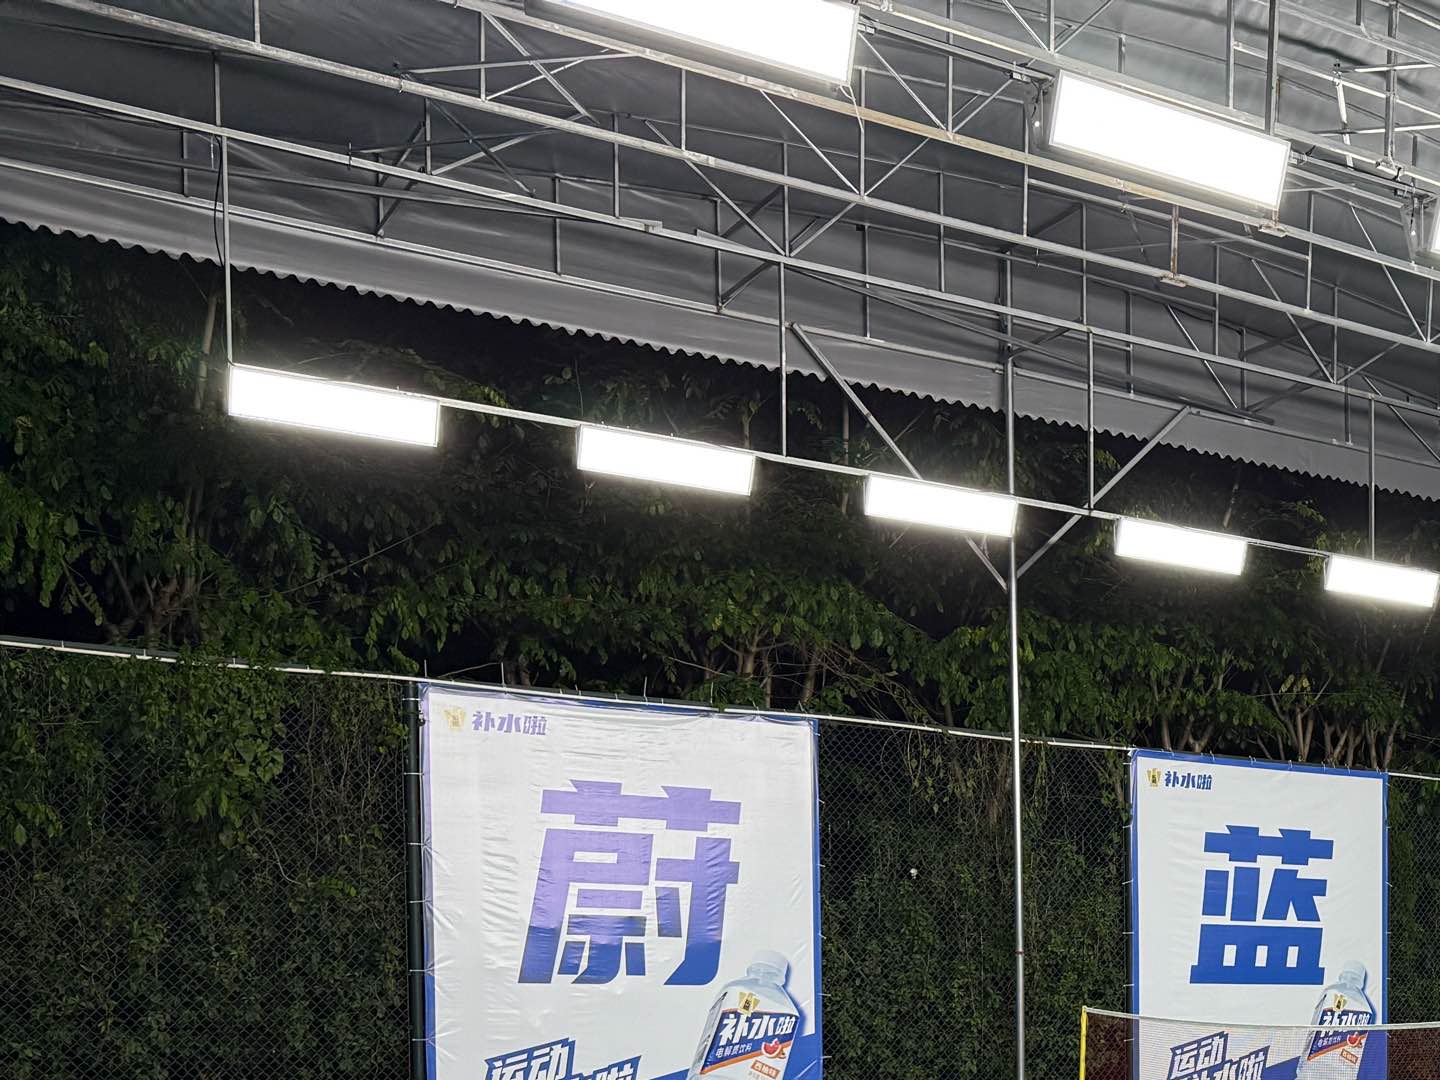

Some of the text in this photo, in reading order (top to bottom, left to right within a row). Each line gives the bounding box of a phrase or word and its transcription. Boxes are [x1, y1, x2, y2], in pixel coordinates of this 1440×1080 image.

[471, 711, 548, 736] 补水啦
[1164, 771, 1213, 790] 补水啦
[518, 779, 741, 985] 蔚
[1189, 825, 1334, 985] 蓝
[719, 1013, 797, 1046] 补水啦
[1320, 1011, 1370, 1037] 补水啦
[1170, 1036, 1224, 1079] 运动
